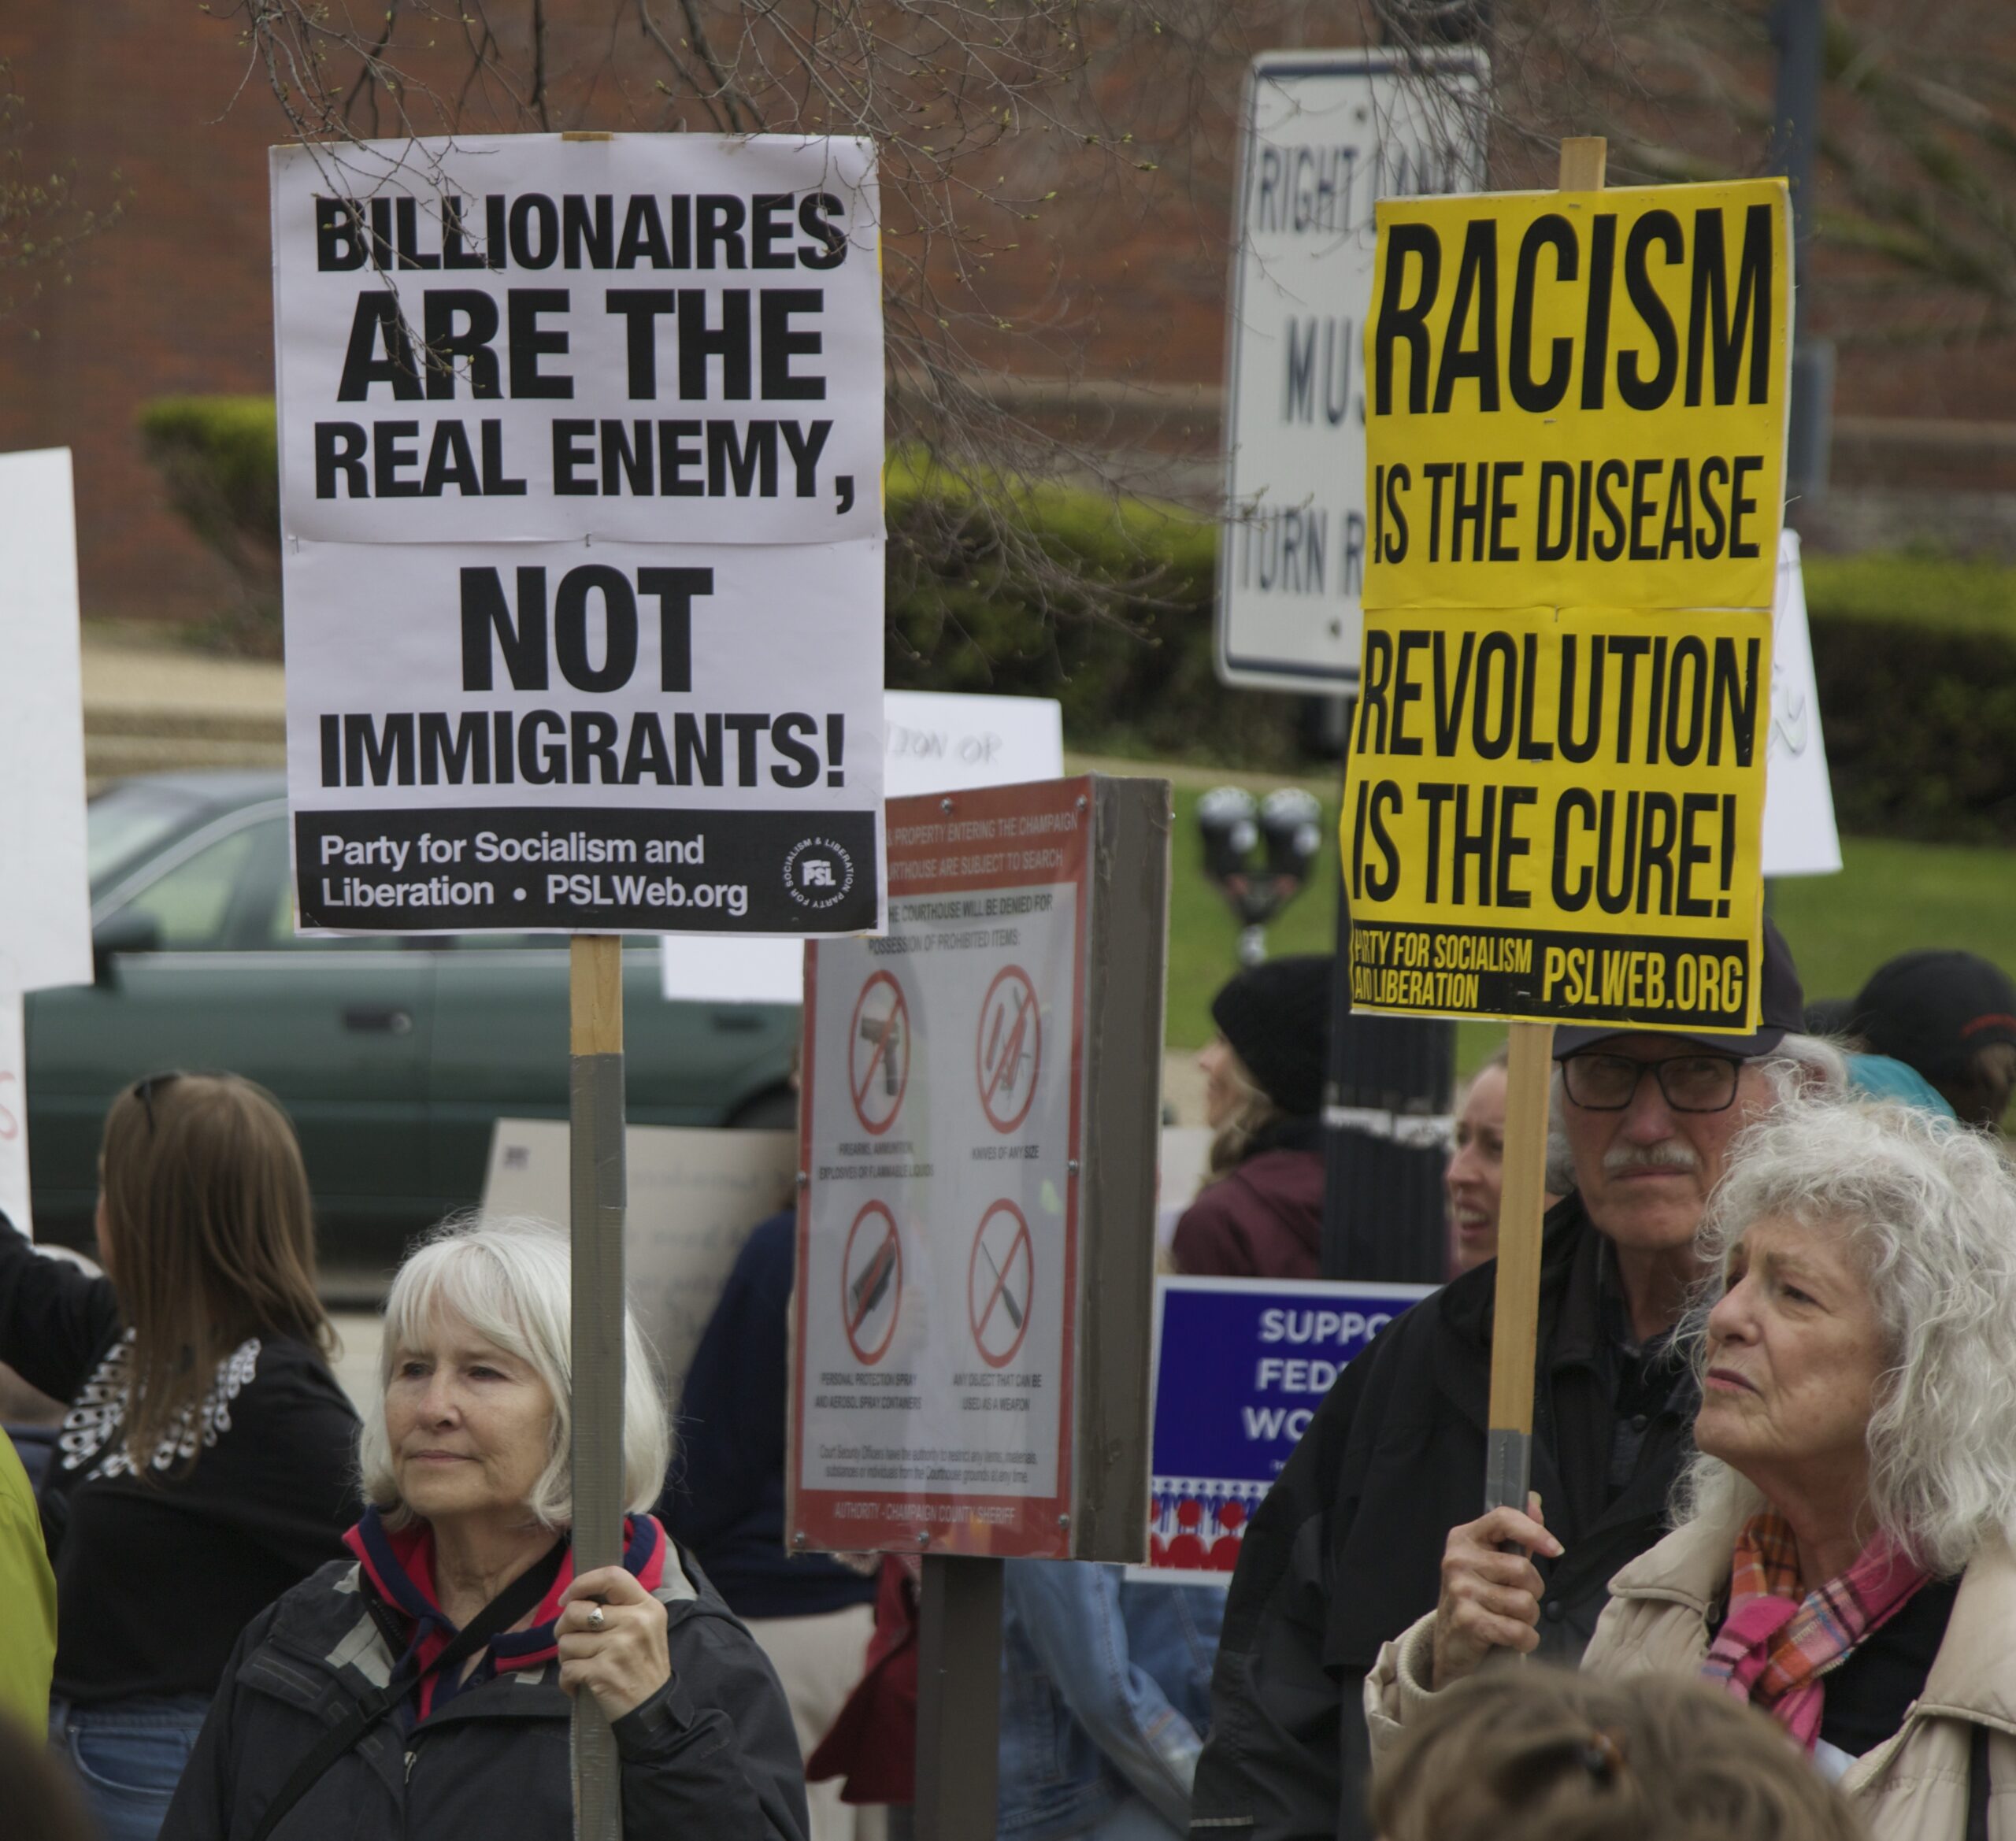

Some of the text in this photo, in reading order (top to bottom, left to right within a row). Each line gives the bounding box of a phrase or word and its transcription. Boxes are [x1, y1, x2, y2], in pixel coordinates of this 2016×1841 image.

[1260, 144, 1357, 233] RIGHT
[315, 193, 848, 273] BILLIONAIRES
[1375, 203, 1772, 417] RACISM
[337, 289, 826, 402] ARE THE
[1286, 317, 1366, 425] MU
[315, 419, 854, 514] REAL ENEMY,
[1375, 456, 1764, 565] IS THE DISEASE
[460, 564, 714, 693] NOT
[1356, 630, 1761, 768] REVOLUTION
[320, 709, 844, 787] IMMIGRANTS!
[894, 824, 945, 846] PROPERTY
[947, 819, 996, 843] ENTERING
[998, 817, 1017, 838] THE
[1019, 811, 1079, 835] CHAMPAIGN
[1352, 780, 1736, 919] IS THE CURE!
[321, 832, 704, 872] Party for Socialism and
[784, 838, 813, 887] SOCIALISM
[824, 838, 854, 892] LIBERATION
[938, 855, 958, 877] ARE
[960, 852, 1004, 875] SUBJECT
[1005, 852, 1021, 872] TO
[1023, 848, 1065, 871] SEARCH
[323, 874, 747, 916] Liberation PSLWeb.org
[802, 866, 836, 886] PSL
[790, 888, 845, 909] PARTY FOR
[902, 901, 962, 922] COURTHOUSE
[963, 898, 984, 918] WILL
[986, 898, 999, 916] BE
[1000, 895, 1032, 915] DENIED
[1034, 893, 1054, 913] FOR
[869, 934, 922, 955] POSSESSION
[924, 932, 937, 952] OF
[938, 930, 991, 950] PROHIBITED
[1392, 932, 1430, 968] FOR
[1432, 934, 1532, 974] SOCIALISM
[1373, 968, 1479, 1009] LIBERATION
[1542, 946, 1744, 1013] PSLWEB.ORG
[1024, 1145, 1040, 1160] SIZE
[1032, 1373, 1042, 1388] BE
[1254, 1357, 1349, 1395] FED
[834, 1501, 881, 1521] AUTHORITY
[886, 1502, 937, 1522] CHAMPAIGN
[939, 1504, 975, 1524] COUNTY
[977, 1505, 1016, 1525] SHERIFF
